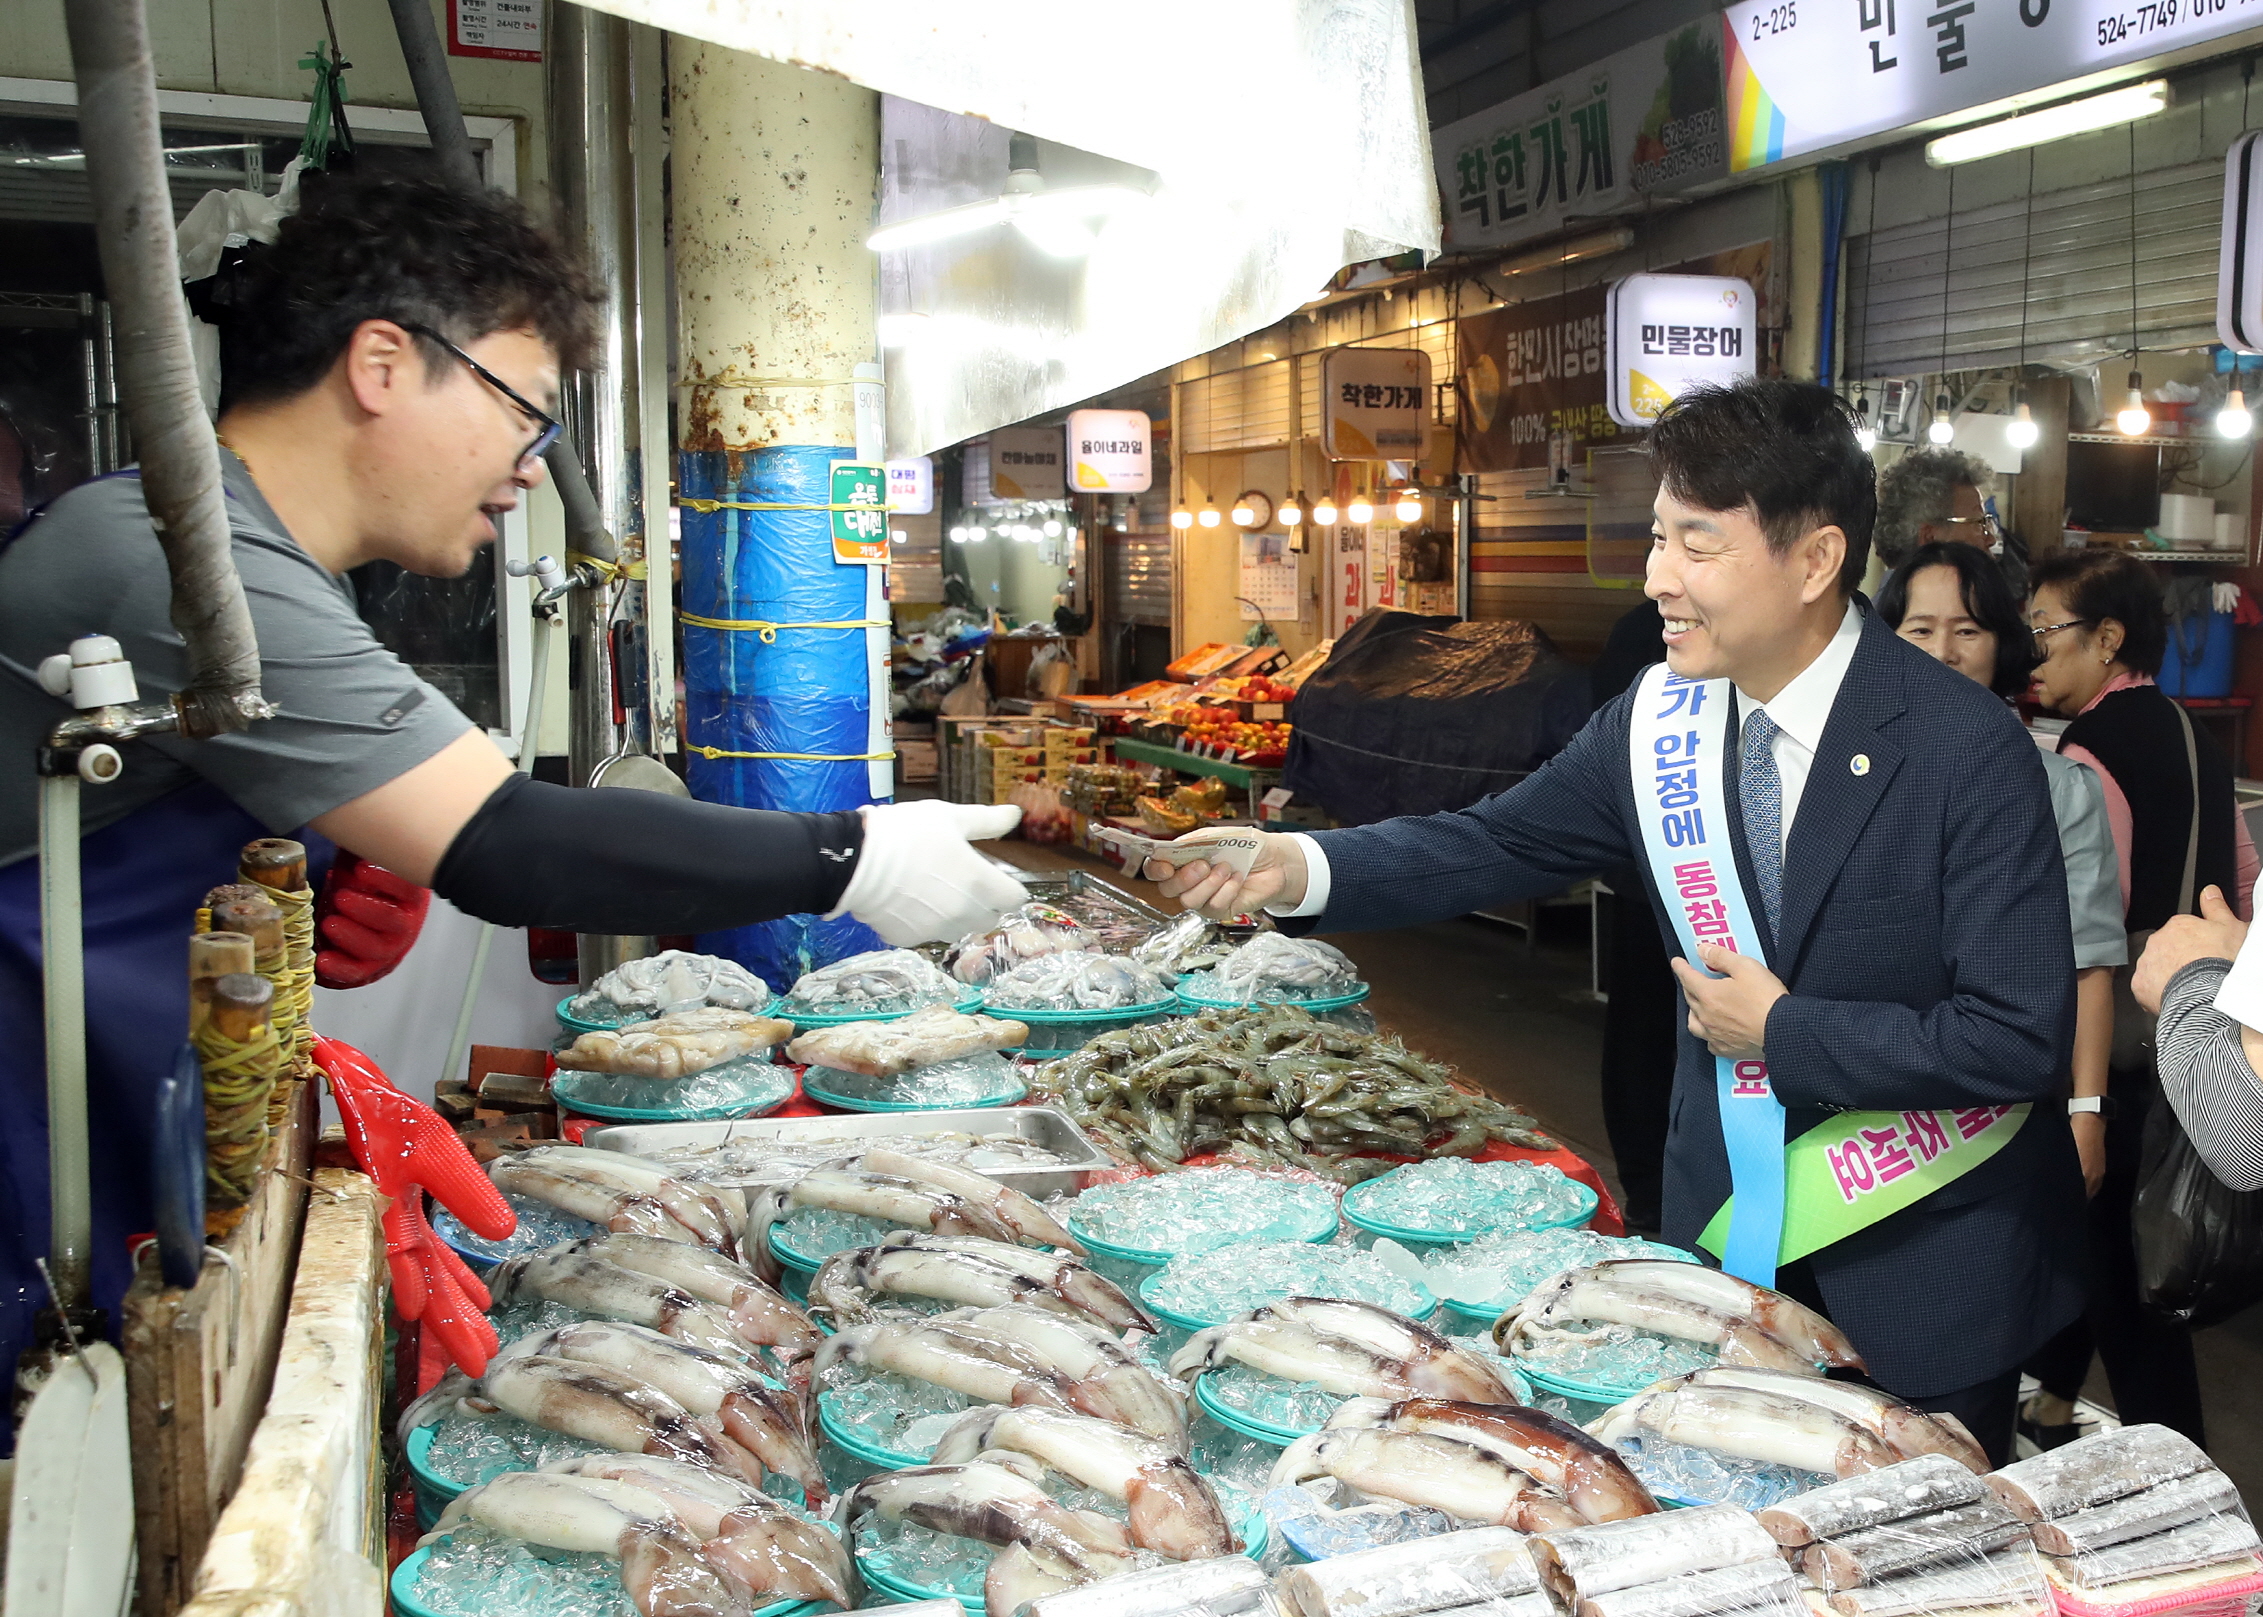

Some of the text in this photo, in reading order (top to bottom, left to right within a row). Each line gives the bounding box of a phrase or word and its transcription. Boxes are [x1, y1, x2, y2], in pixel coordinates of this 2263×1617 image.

[497, 2, 531, 13] 건물내외부
[497, 20, 520, 29] 24시간
[1752, 2, 1797, 41] 2-225
[2097, 0, 2178, 46] 524-7749
[1662, 108, 1718, 148] 528-9592
[1456, 80, 1614, 228] 착한가게
[1636, 142, 1720, 188] 010-5805-9592
[1641, 324, 1742, 357] 민물장어
[1342, 383, 1422, 409] 착한가게
[1510, 413, 1546, 445] 100%
[1081, 441, 1142, 454] 율이네과일
[1654, 730, 1706, 847] 안정에
[1217, 838, 1259, 851] 5000
[1827, 1109, 1950, 1201] 주세요
